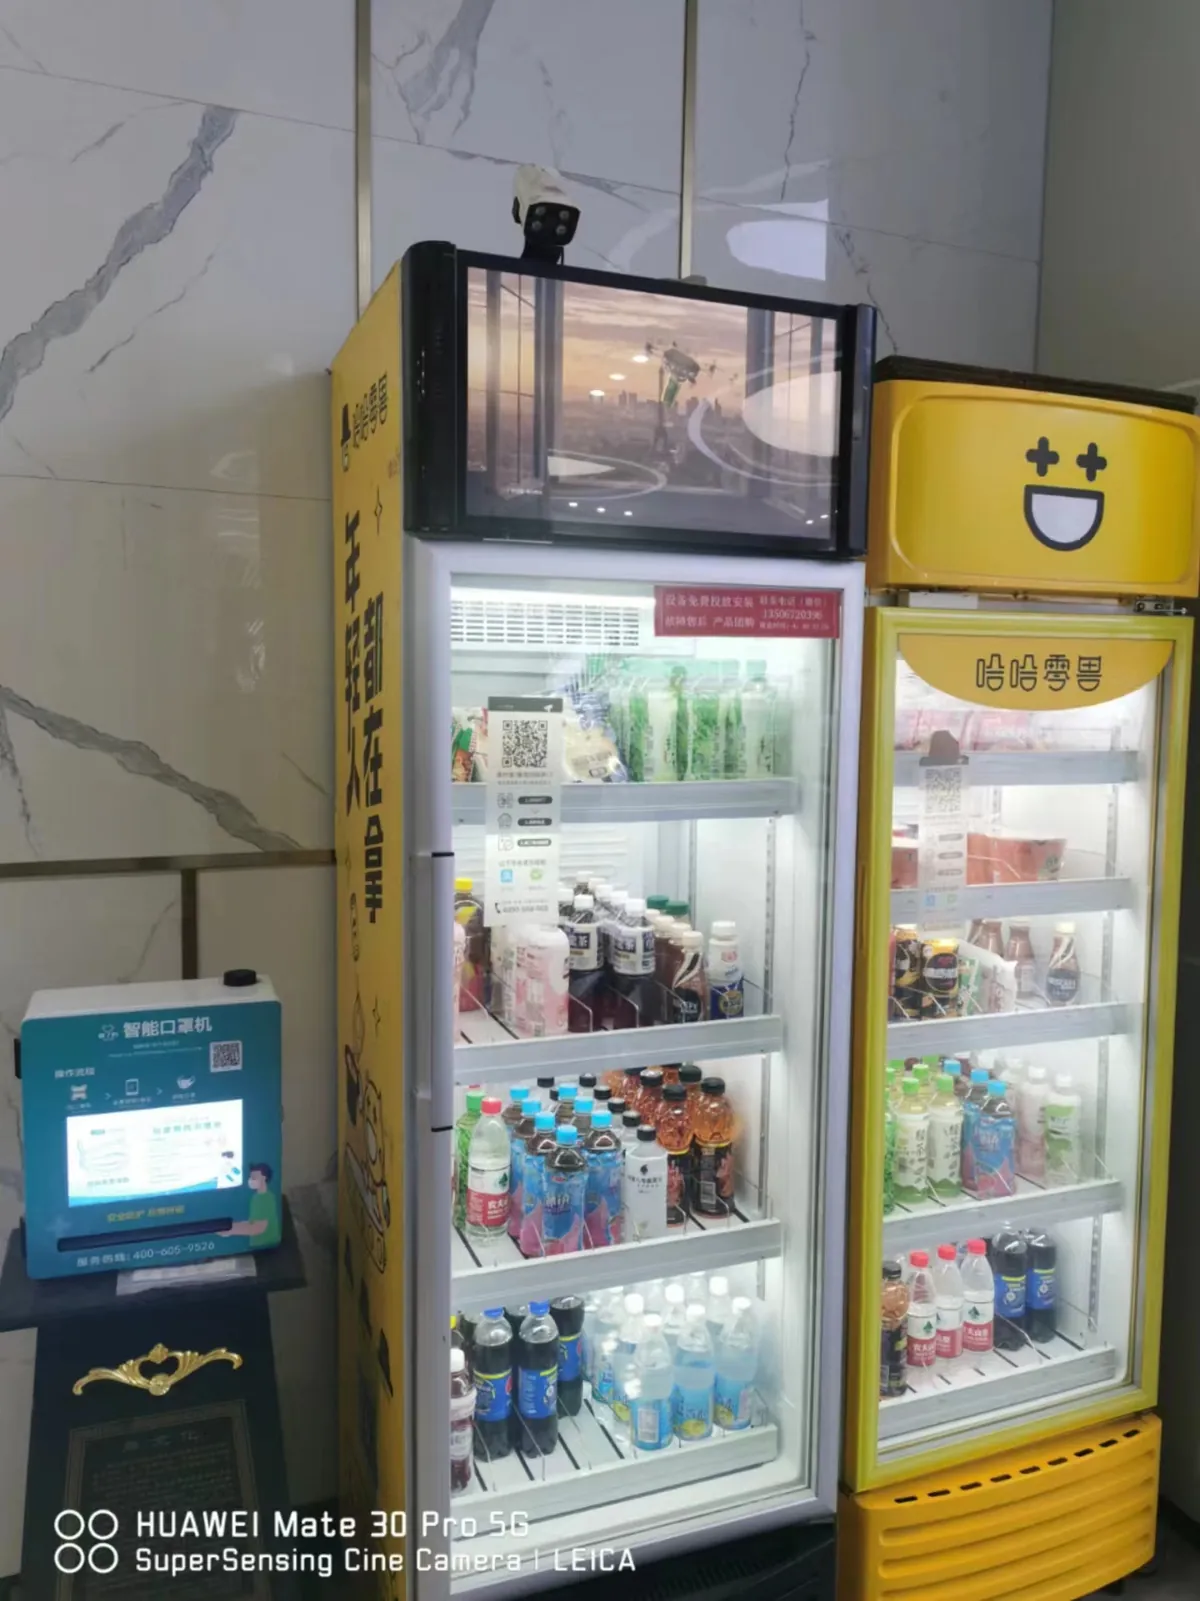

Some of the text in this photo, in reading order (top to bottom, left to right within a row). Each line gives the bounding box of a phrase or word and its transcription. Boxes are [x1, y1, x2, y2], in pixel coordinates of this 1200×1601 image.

[344, 509, 361, 817] 年轻人
[976, 653, 1102, 692] 哈哈零兽
[123, 1016, 213, 1039] 智能口罩机
